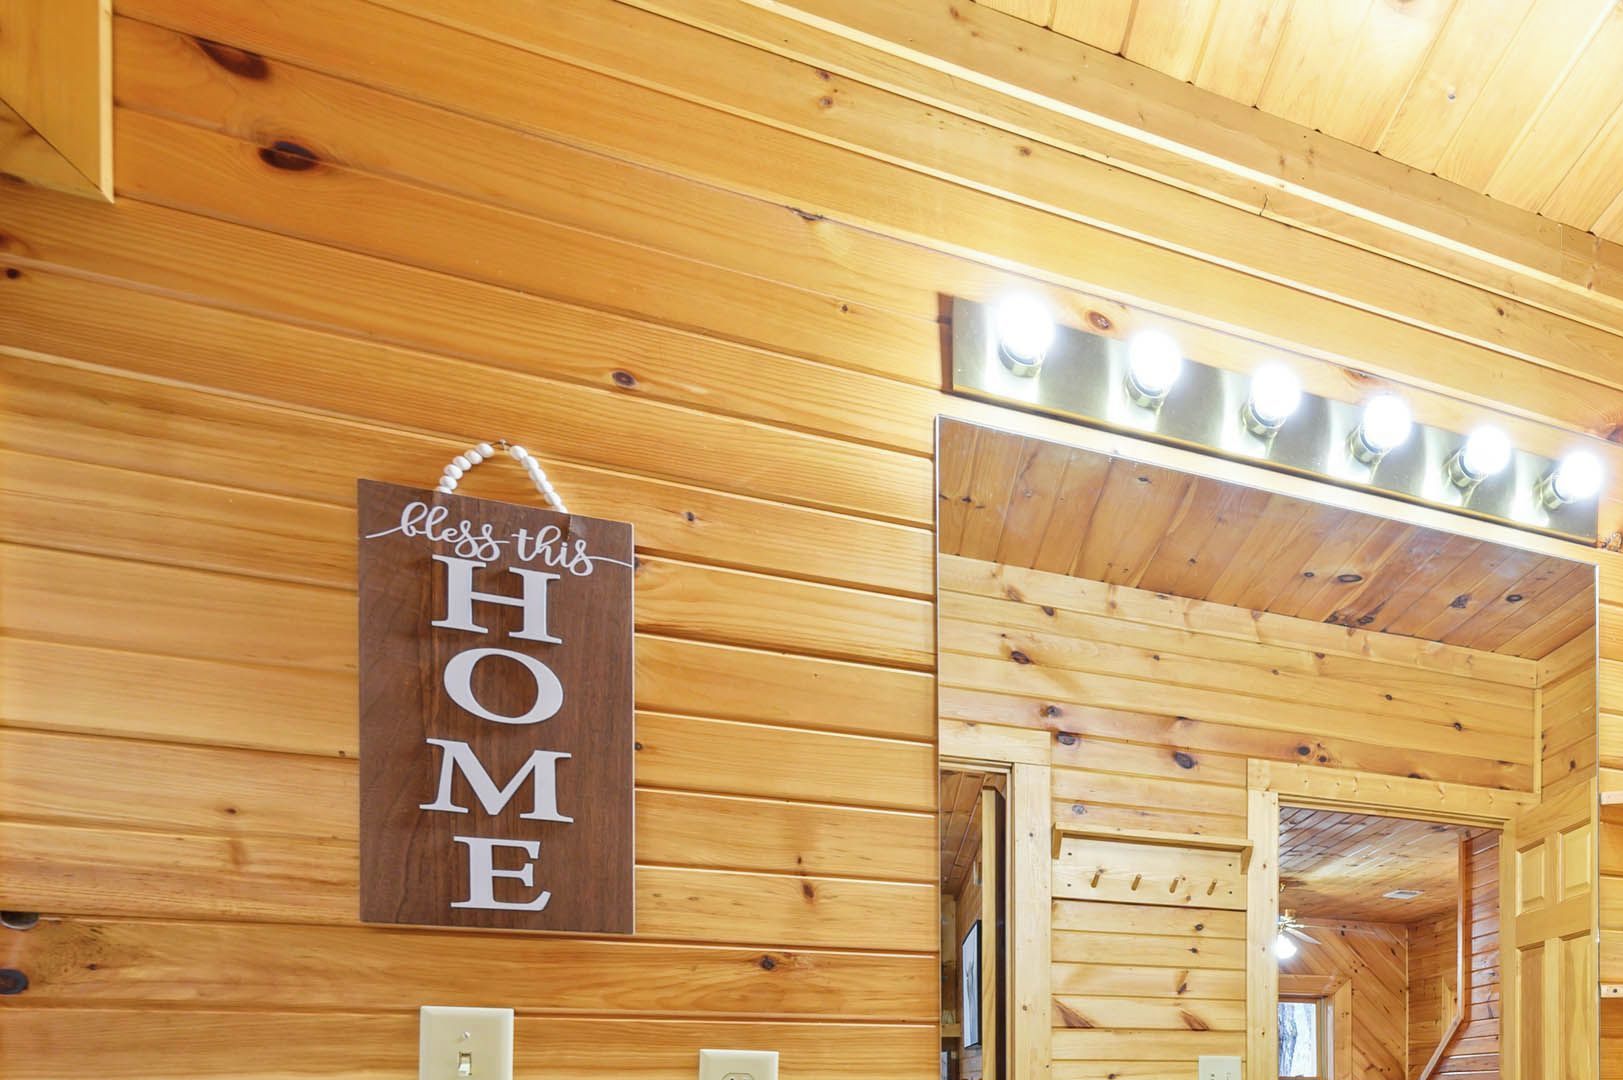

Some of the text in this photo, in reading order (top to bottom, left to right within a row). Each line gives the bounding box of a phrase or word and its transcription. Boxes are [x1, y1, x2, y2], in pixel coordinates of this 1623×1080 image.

[365, 501, 633, 577] bless this
[420, 554, 574, 911] HOME
